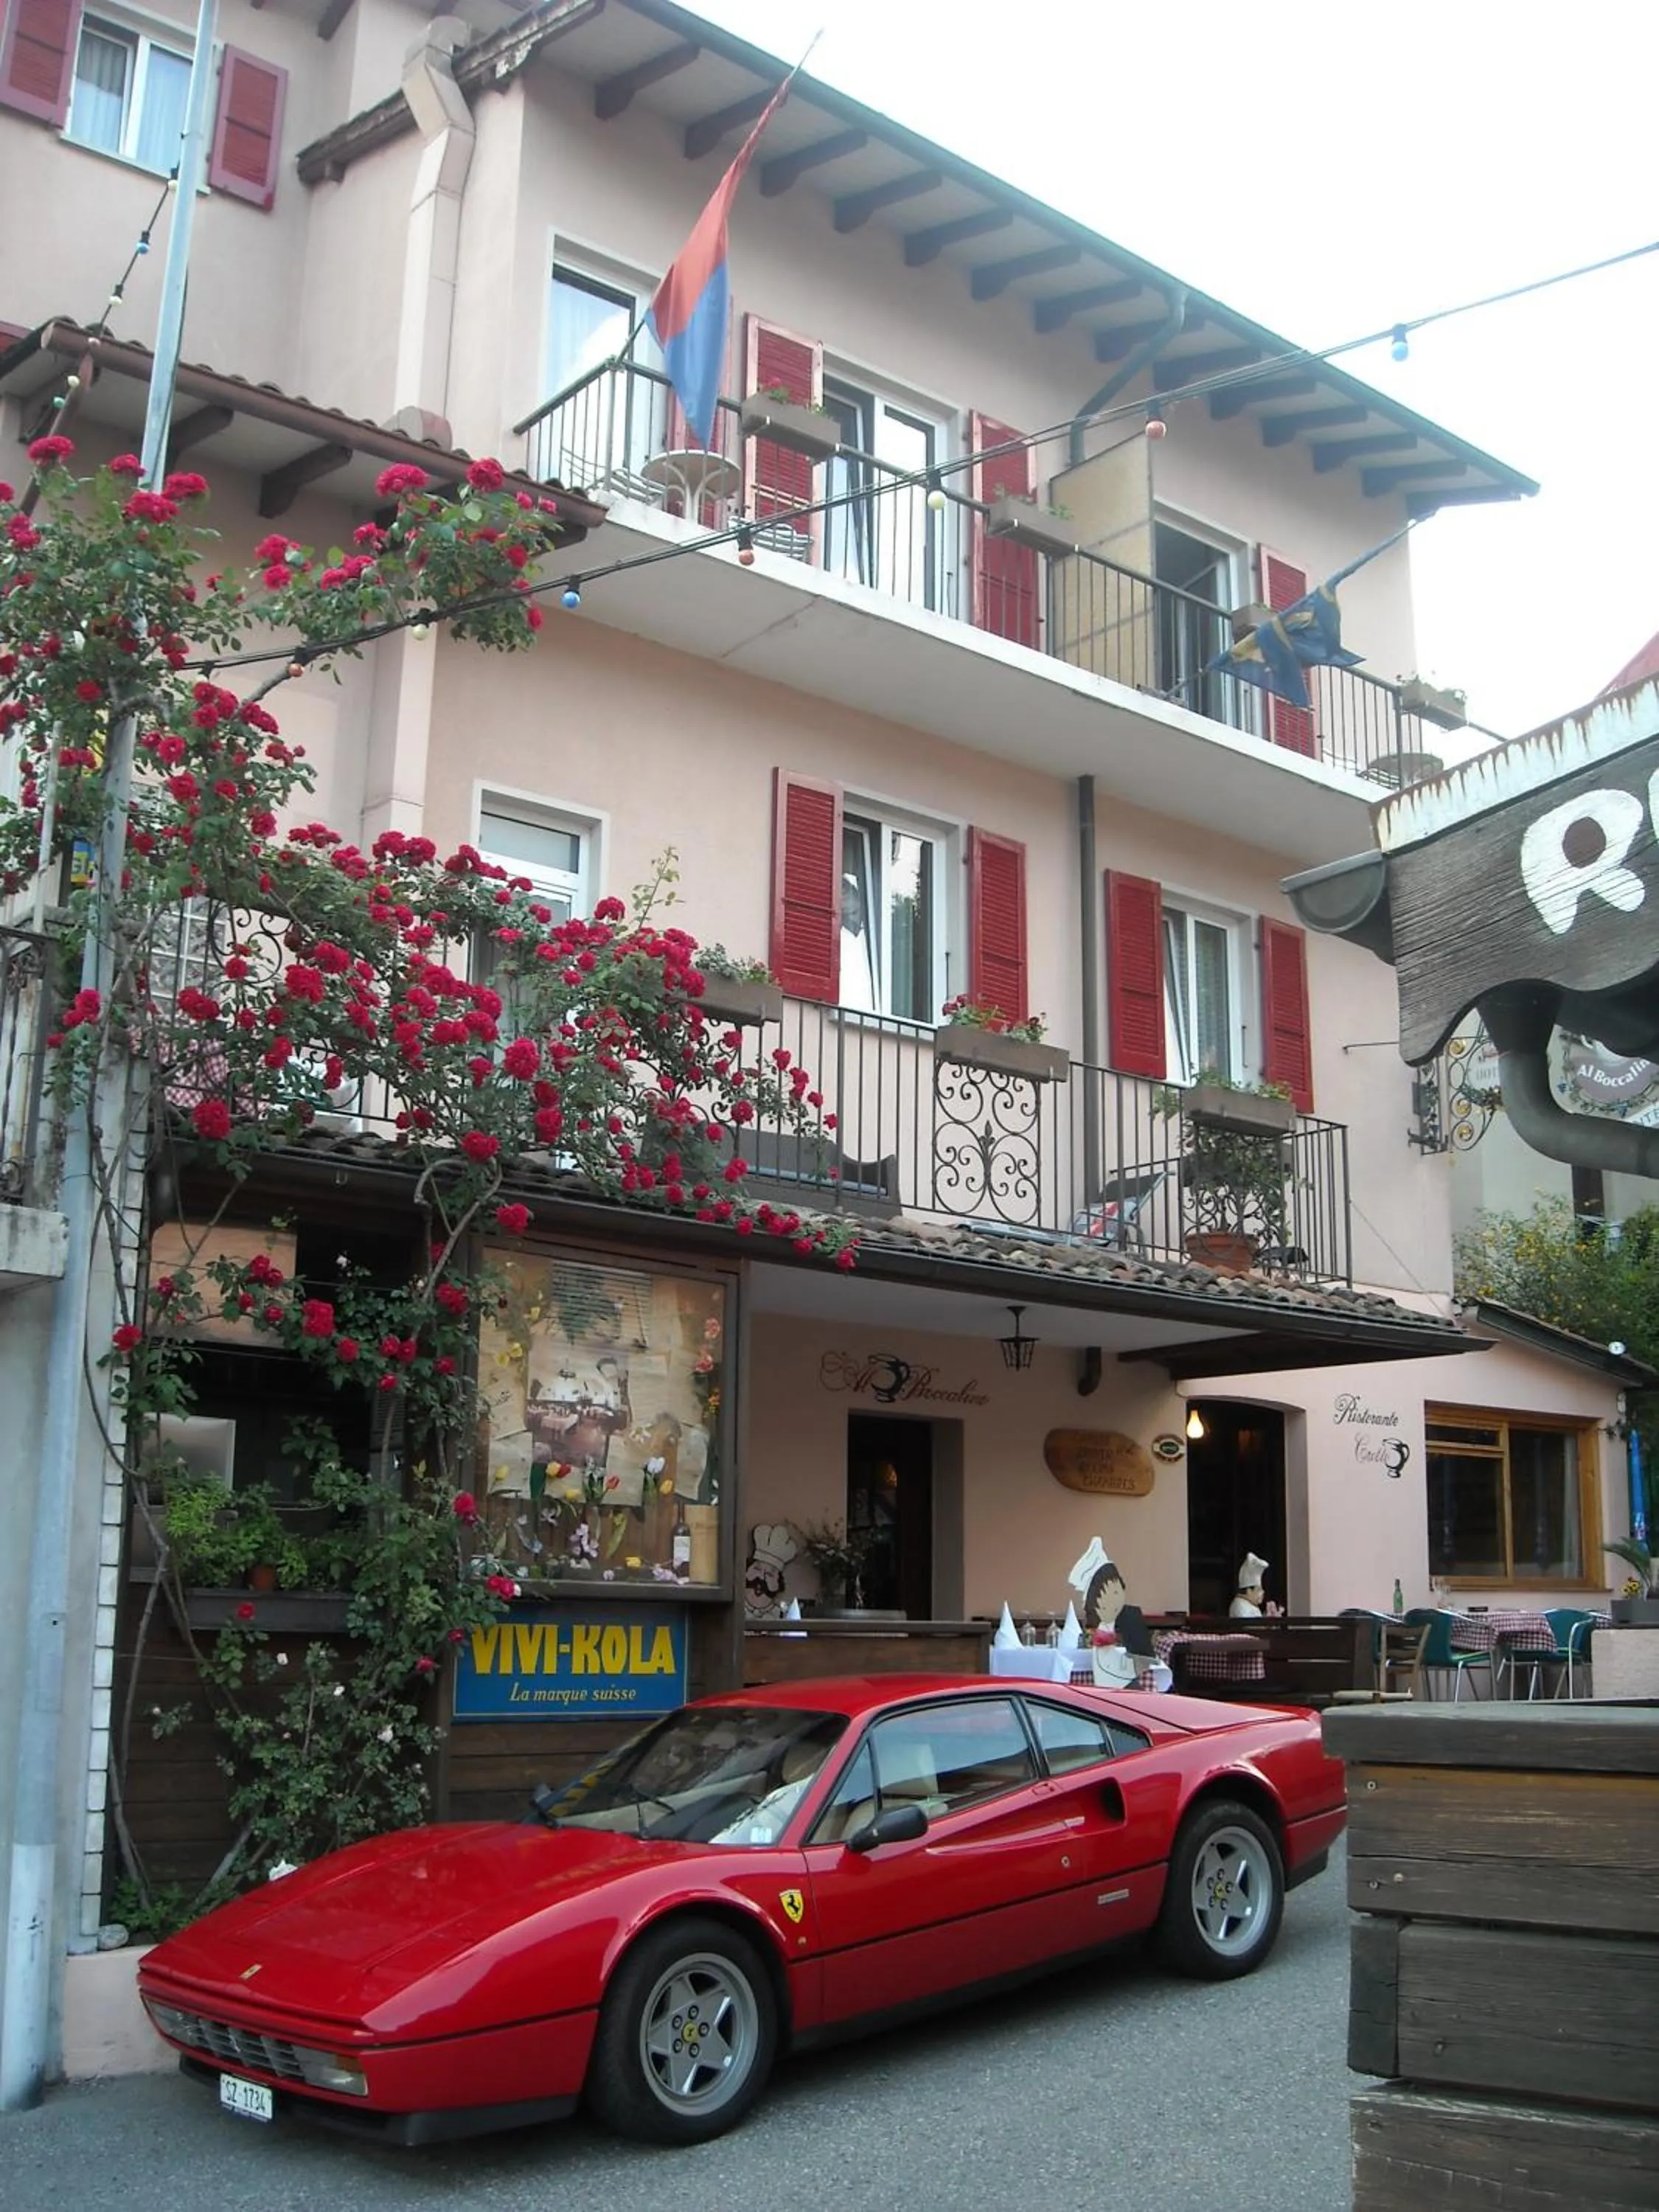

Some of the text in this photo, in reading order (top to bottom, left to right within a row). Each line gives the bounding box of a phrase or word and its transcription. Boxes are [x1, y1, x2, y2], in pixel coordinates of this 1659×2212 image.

[1577, 1059, 1651, 1088] Al Boccalin
[1333, 1393, 1399, 1427] Ristorante
[471, 1624, 676, 1674] VIVI-KOLA
[509, 1681, 636, 1705] La marque suisse
